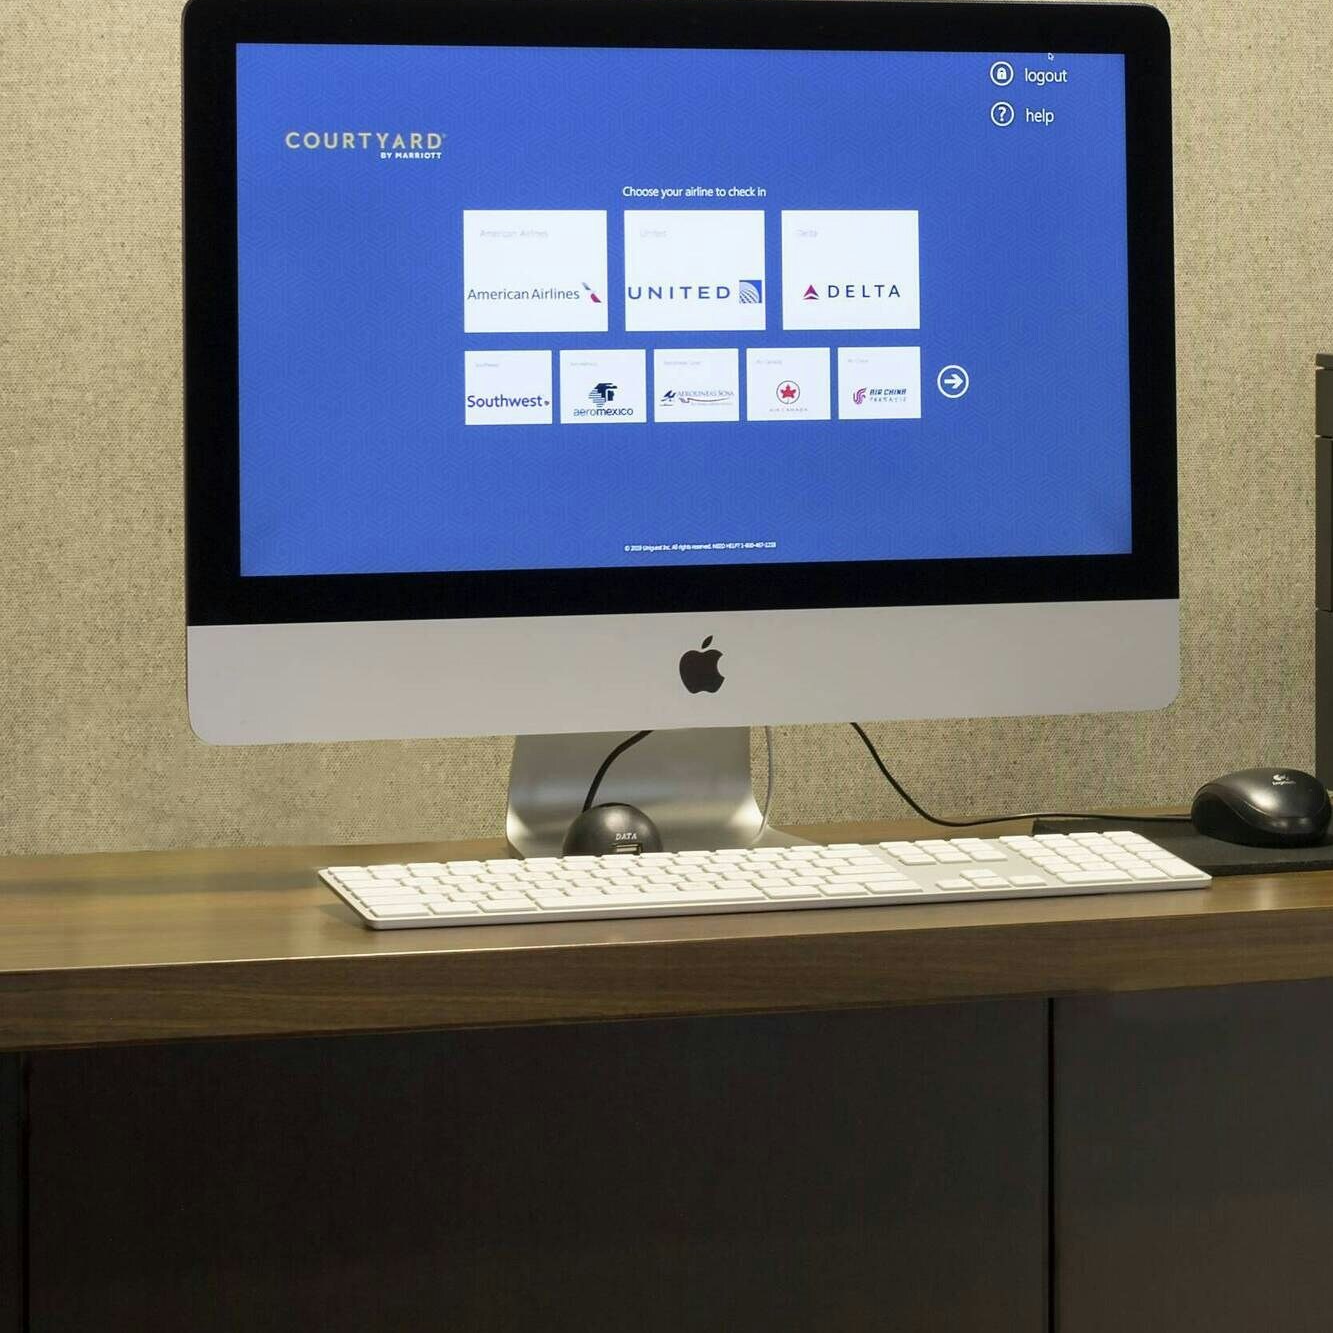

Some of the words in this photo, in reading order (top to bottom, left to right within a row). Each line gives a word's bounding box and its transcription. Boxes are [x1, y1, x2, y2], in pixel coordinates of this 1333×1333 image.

[1024, 67, 1068, 86] logout
[1025, 108, 1055, 127] help
[285, 131, 443, 150] COURTYARD
[622, 186, 659, 197] Choose
[660, 187, 683, 200] your
[685, 186, 714, 197] airline
[715, 186, 727, 197] to
[728, 186, 756, 197] check
[757, 186, 767, 197] in
[467, 288, 530, 300] American
[532, 288, 580, 300] Airlines
[627, 286, 731, 300] UNITED
[827, 284, 901, 298] DELTA
[467, 394, 543, 408] Southwest
[573, 407, 634, 417] aeromexico
[615, 832, 637, 841] DATA
